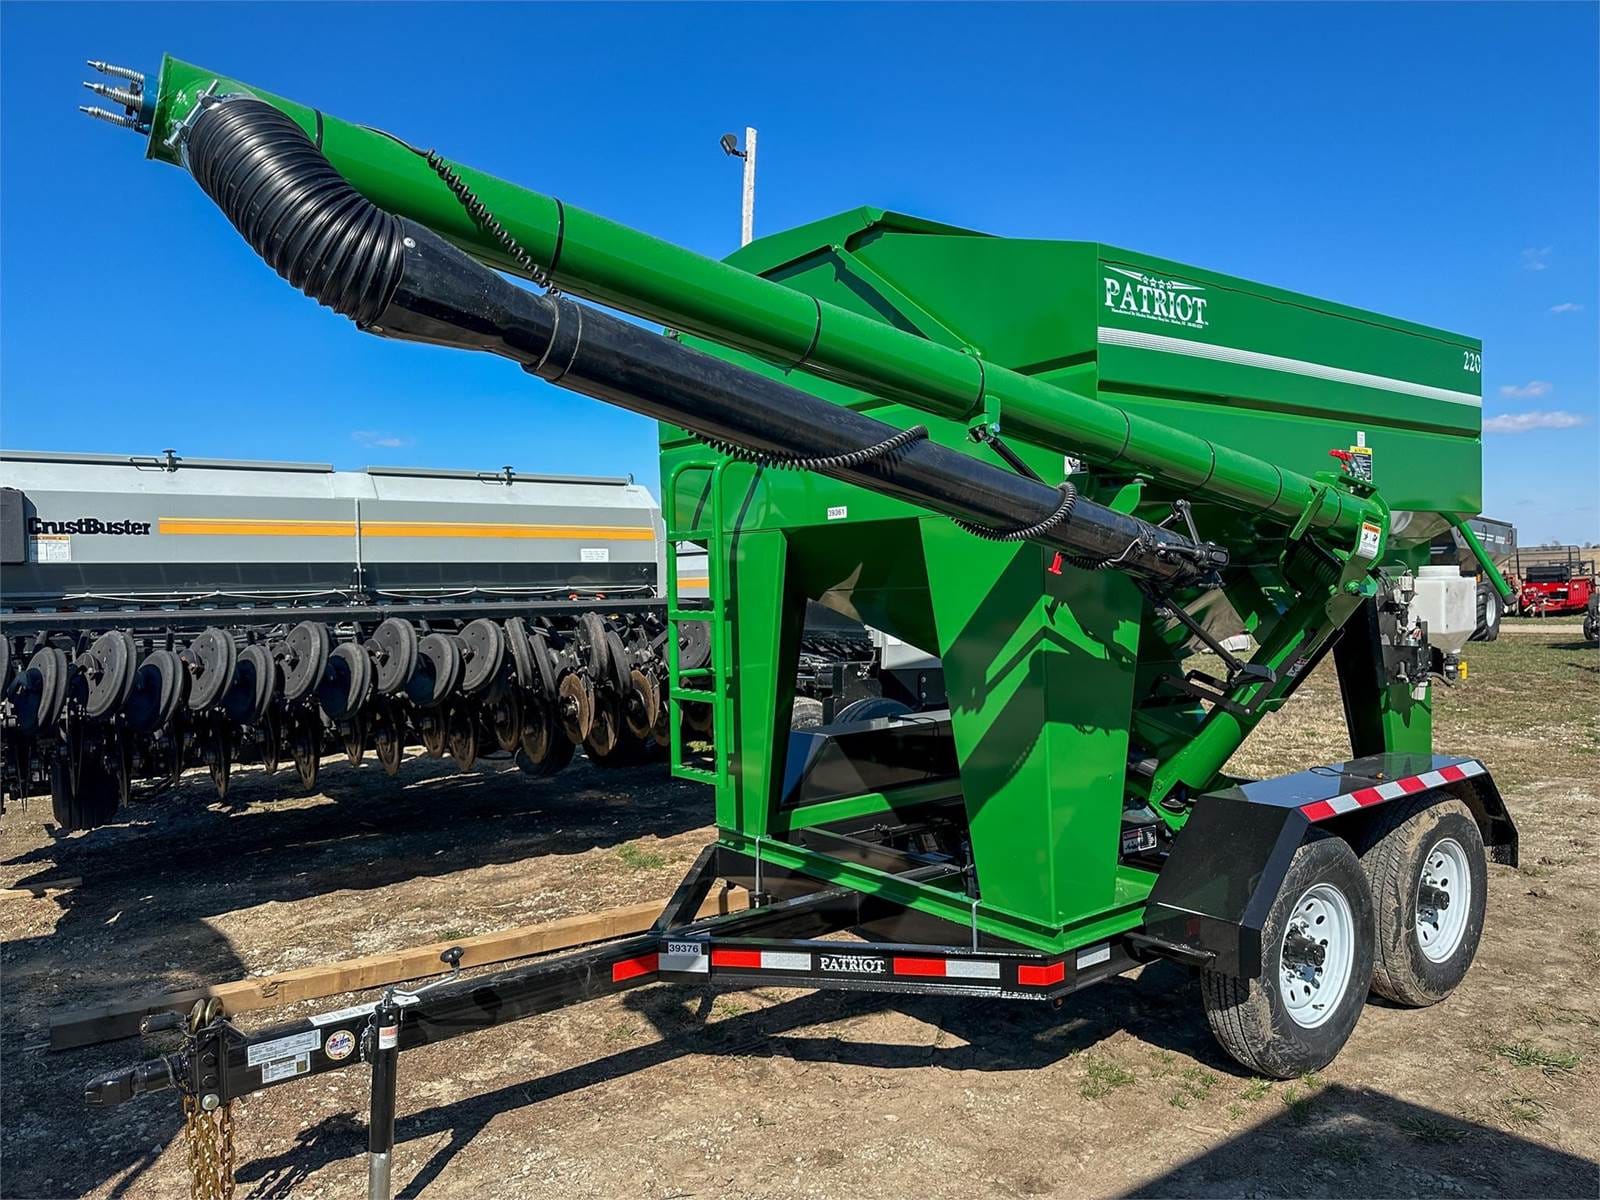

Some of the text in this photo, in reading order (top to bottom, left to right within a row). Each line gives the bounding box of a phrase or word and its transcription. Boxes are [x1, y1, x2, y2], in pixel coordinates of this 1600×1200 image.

[1104, 278, 1207, 324] PATRIOT
[1463, 351, 1481, 373] 220
[28, 517, 151, 535] CrustBuster
[669, 944, 699, 953] 39376
[820, 957, 885, 972] PATRIOT
